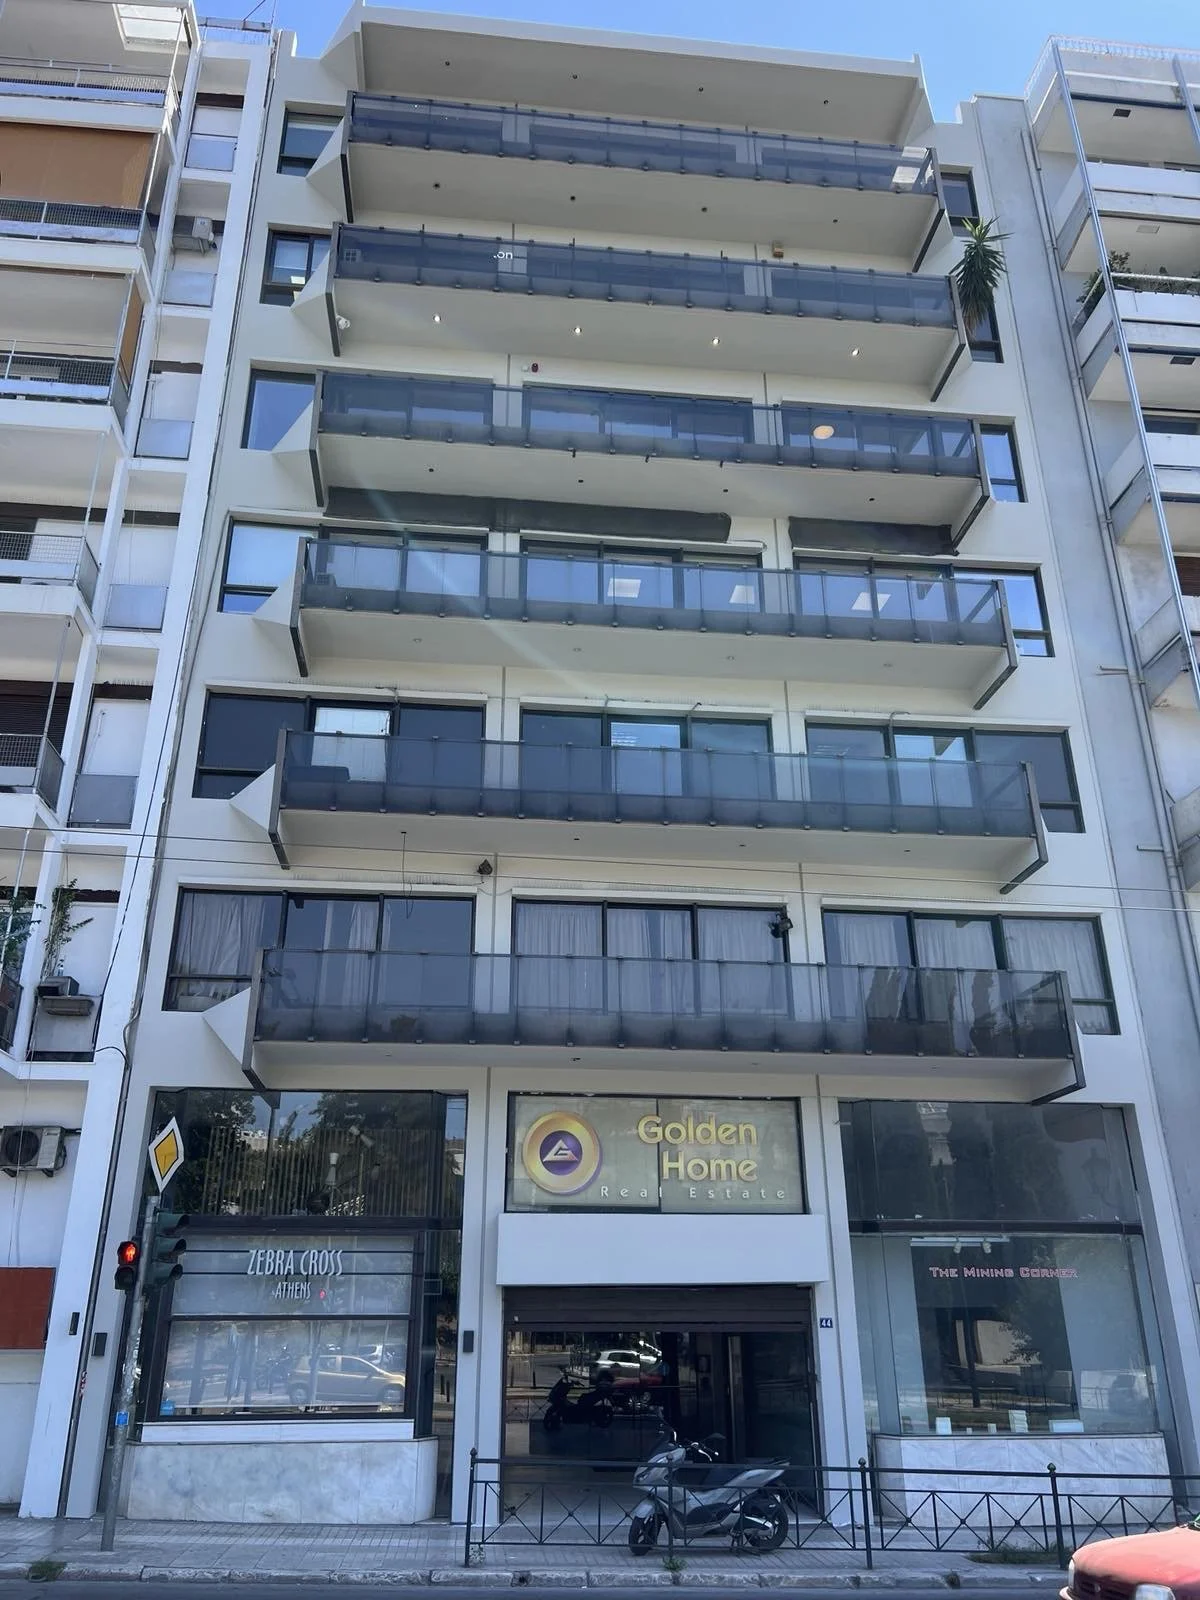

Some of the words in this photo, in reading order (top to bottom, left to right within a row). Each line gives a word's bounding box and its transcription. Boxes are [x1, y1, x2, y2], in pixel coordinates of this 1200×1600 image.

[638, 1112, 757, 1145] Golden
[662, 1150, 758, 1182] Home
[601, 1186, 662, 1199] Real
[689, 1187, 785, 1199] Estate
[247, 1249, 295, 1276] ZEBRA
[300, 1249, 343, 1277] CROSS
[929, 1266, 958, 1278] THE
[274, 1281, 311, 1300] ATHENS
[821, 1319, 831, 1327] 44
